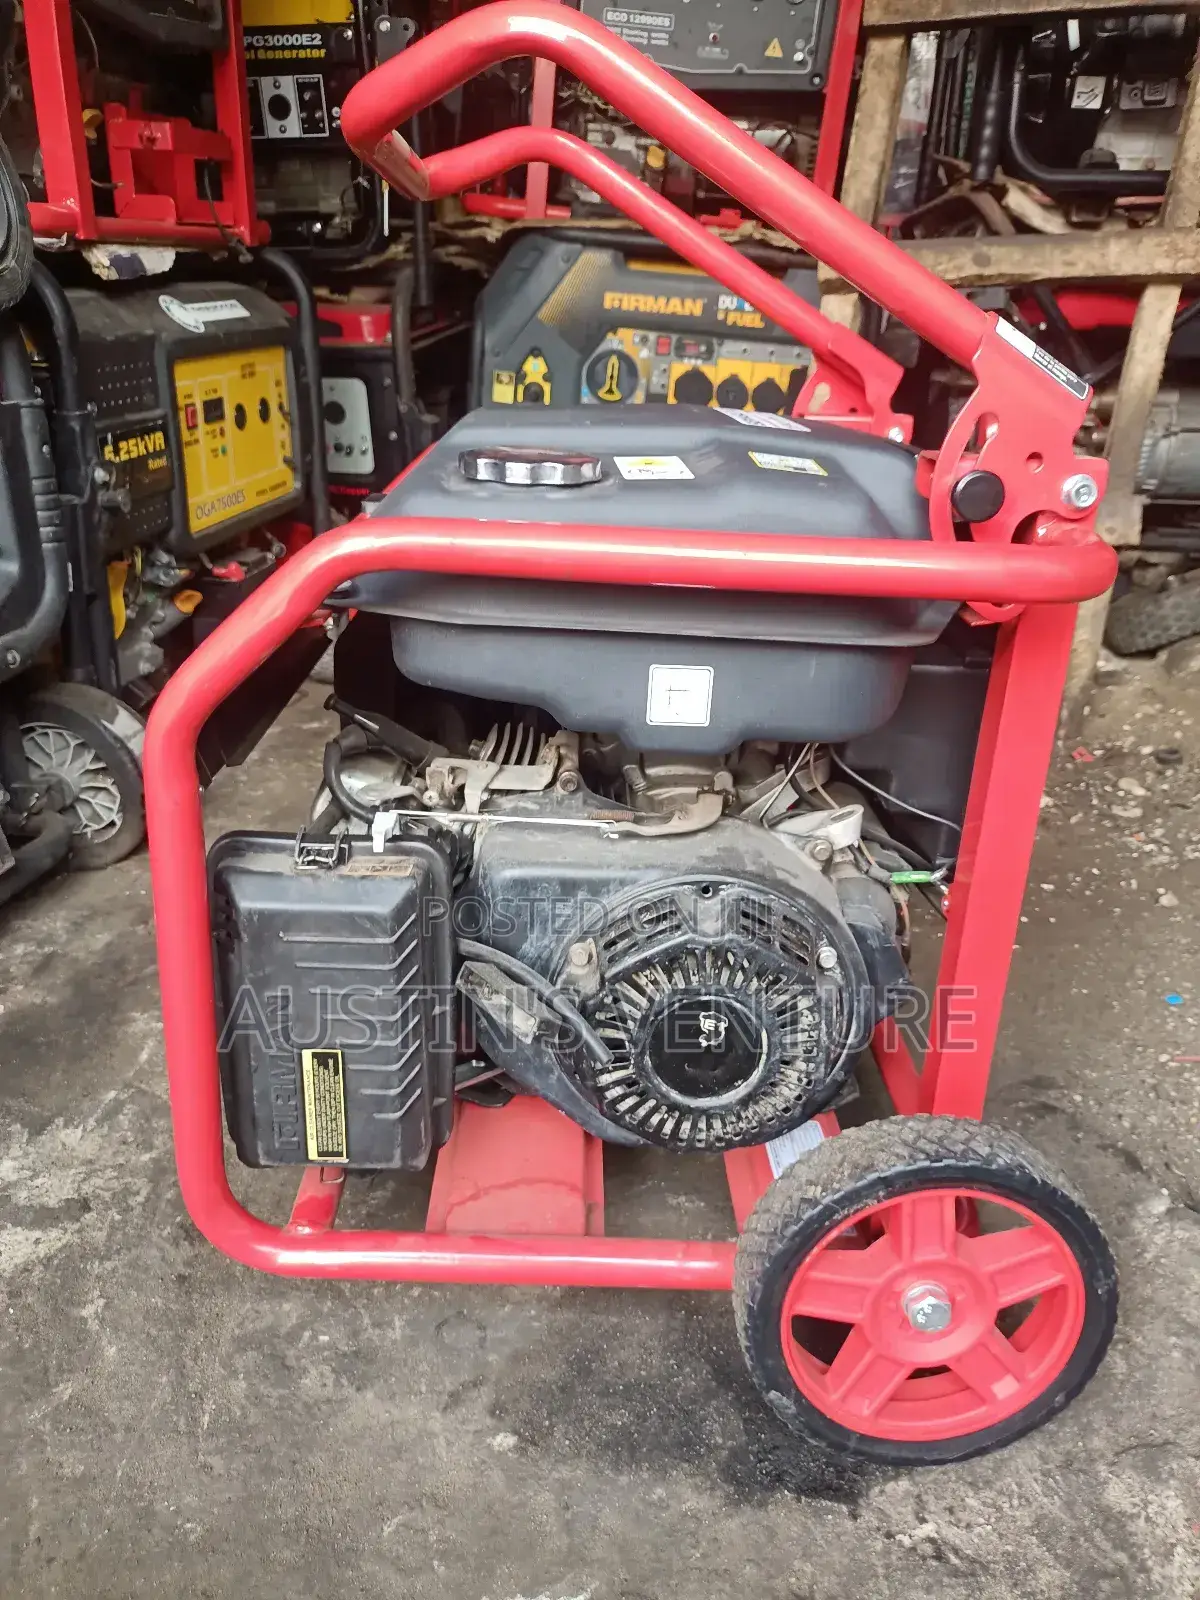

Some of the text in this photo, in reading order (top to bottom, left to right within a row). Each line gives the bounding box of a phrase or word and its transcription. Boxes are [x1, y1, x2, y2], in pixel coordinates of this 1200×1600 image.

[606, 11, 627, 22] ECO
[243, 33, 322, 47] PG3000E2
[257, 48, 326, 59] Generator
[603, 291, 704, 317] FIRMAN
[726, 311, 765, 329] FUEL
[266, 991, 300, 1150] FIRMAN
